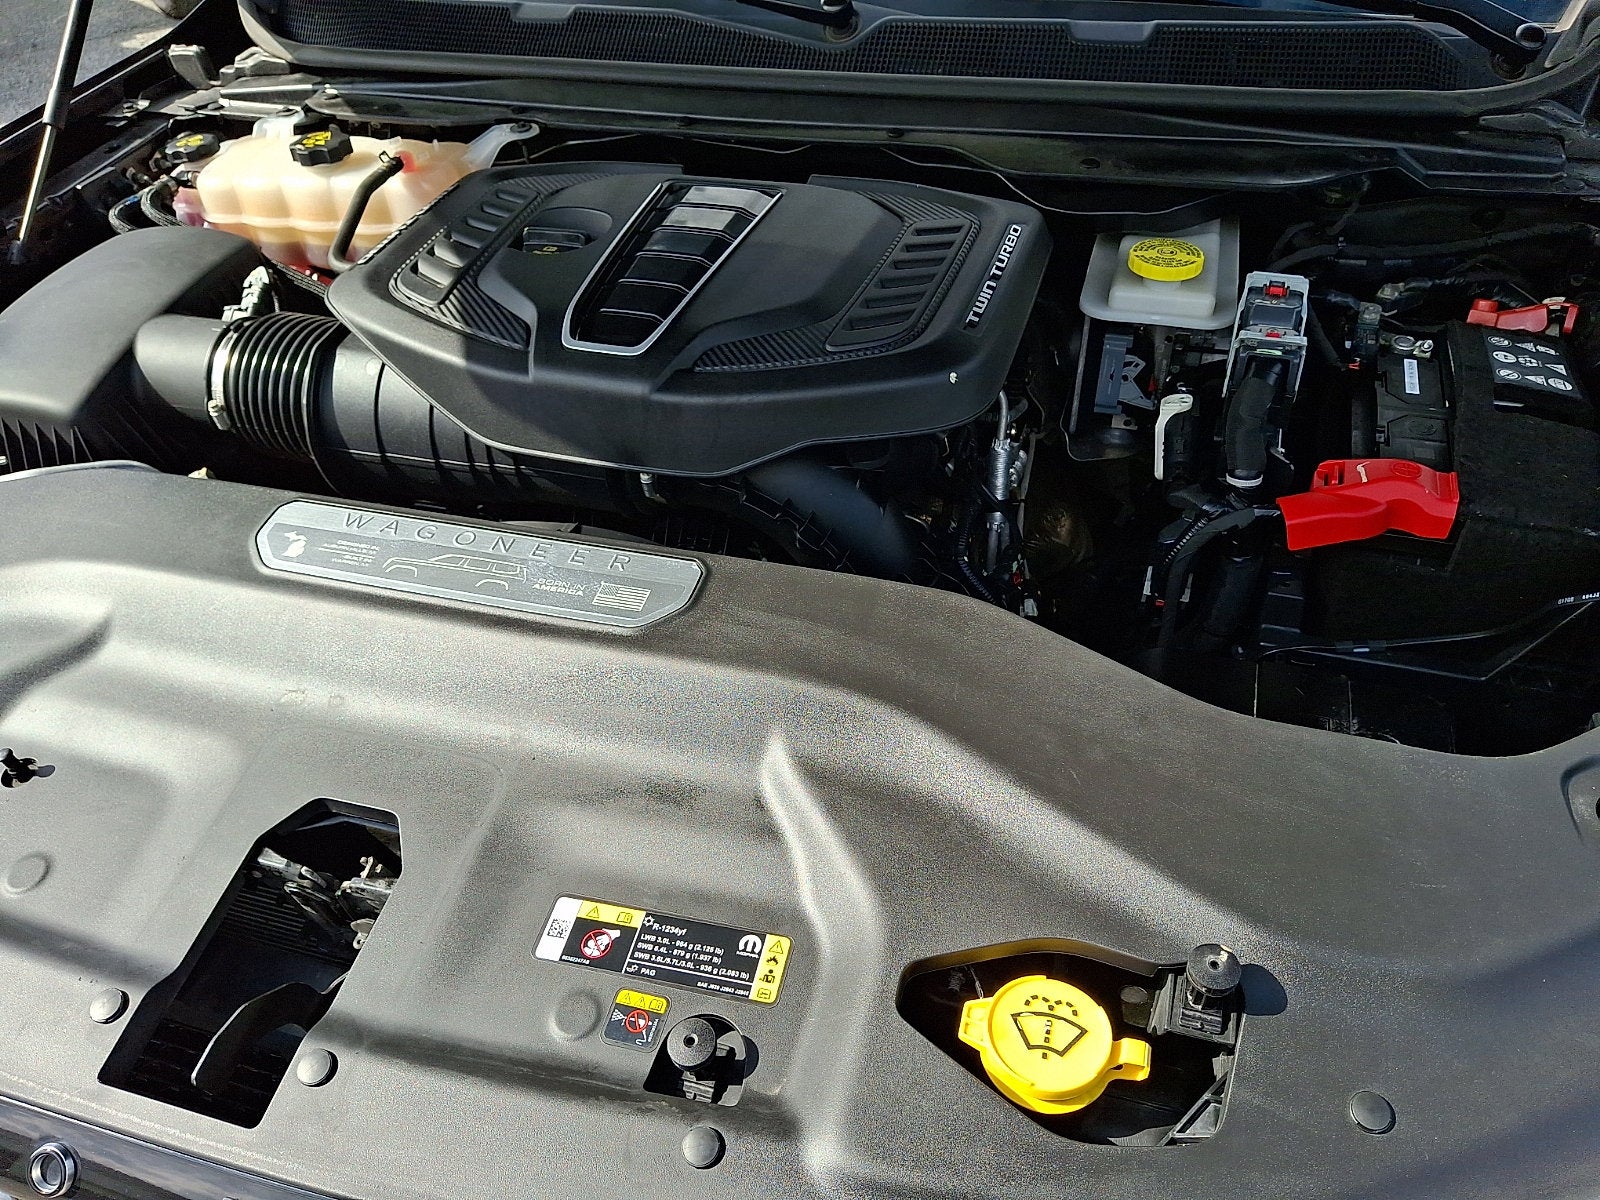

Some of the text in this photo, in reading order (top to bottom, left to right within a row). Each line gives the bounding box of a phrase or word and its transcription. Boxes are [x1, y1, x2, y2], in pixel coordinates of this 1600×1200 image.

[965, 224, 1022, 323] TWIN TURBO
[345, 512, 631, 572] WAGONEER
[532, 583, 584, 597] AMERICA
[537, 578, 571, 588] BORN
[652, 923, 688, 936] R-1234yf
[641, 934, 656, 942] LWB
[656, 936, 671, 945] 3.0L
[637, 942, 653, 951] SWB
[685, 952, 691, 960] g
[634, 951, 650, 960] SWB
[713, 967, 719, 975] g
